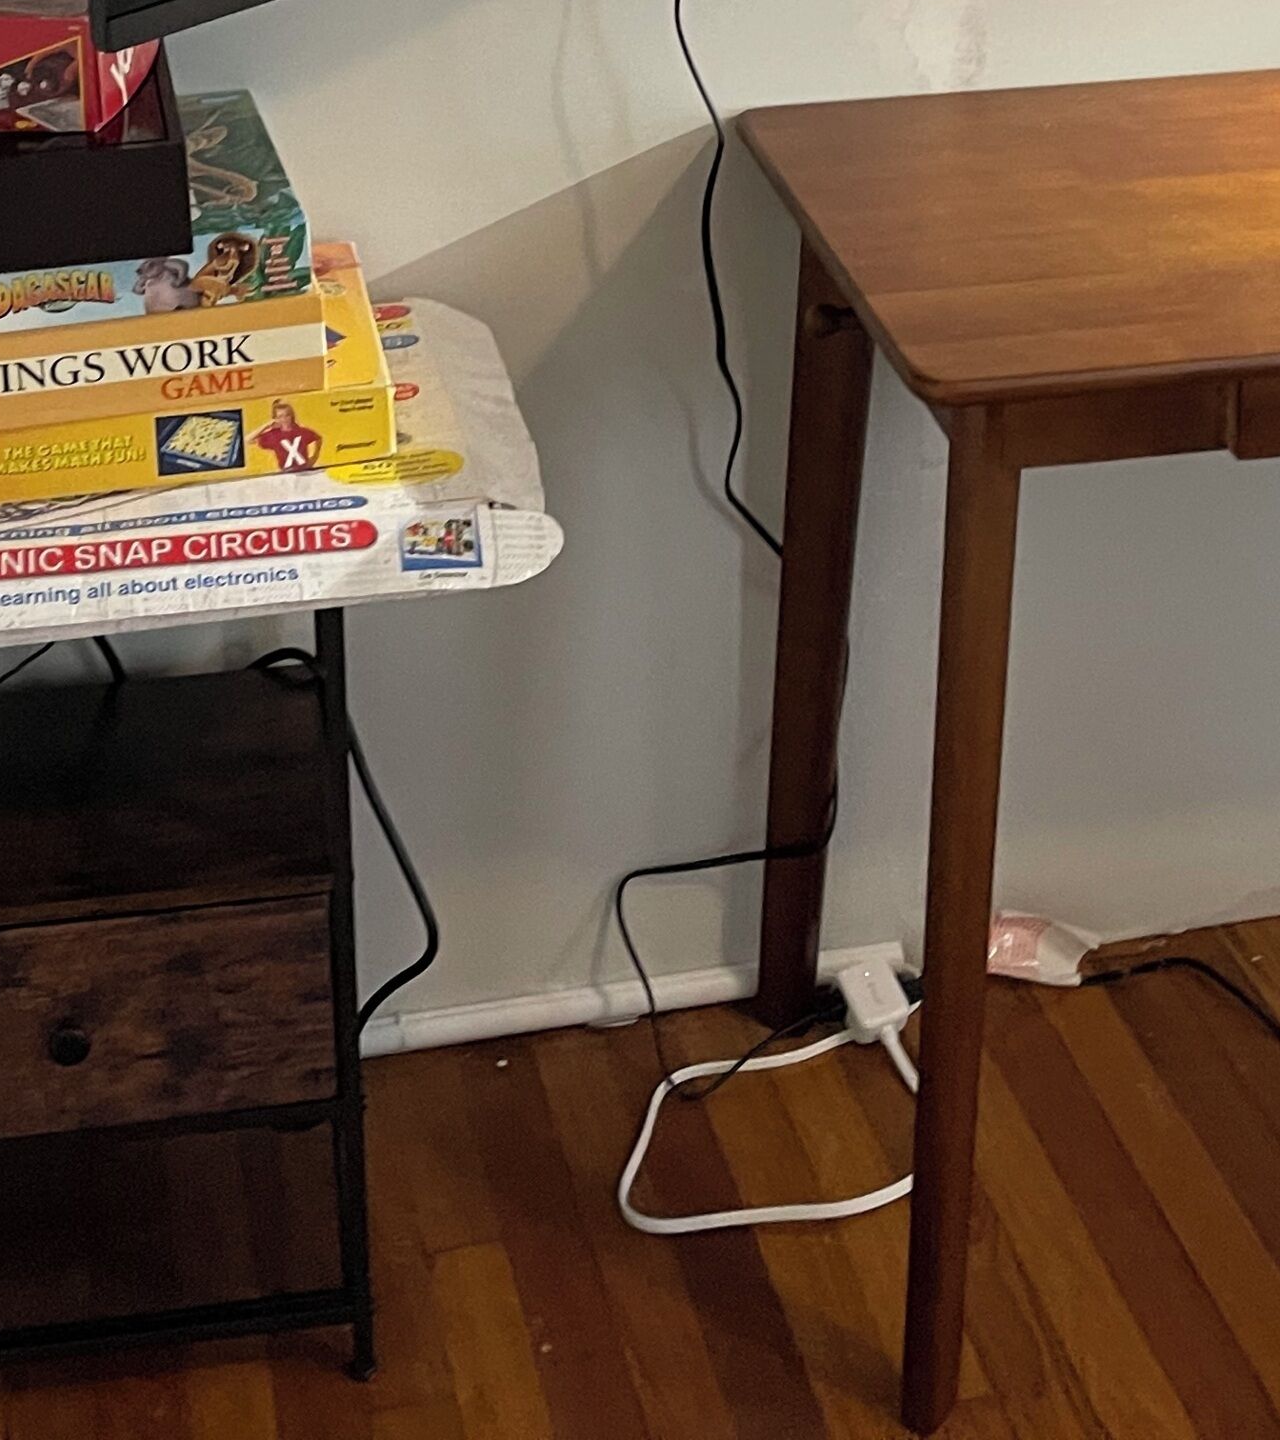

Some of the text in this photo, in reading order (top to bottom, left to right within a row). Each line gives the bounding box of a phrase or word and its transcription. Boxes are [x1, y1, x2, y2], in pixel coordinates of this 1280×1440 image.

[115, 333, 256, 379] WORK
[160, 368, 255, 402] GAME
[279, 436, 306, 468] X
[73, 536, 172, 571] SNAP
[182, 524, 354, 561] CIRCUITS
[86, 579, 114, 598] all
[118, 574, 179, 596] about
[184, 566, 300, 589] electronics
